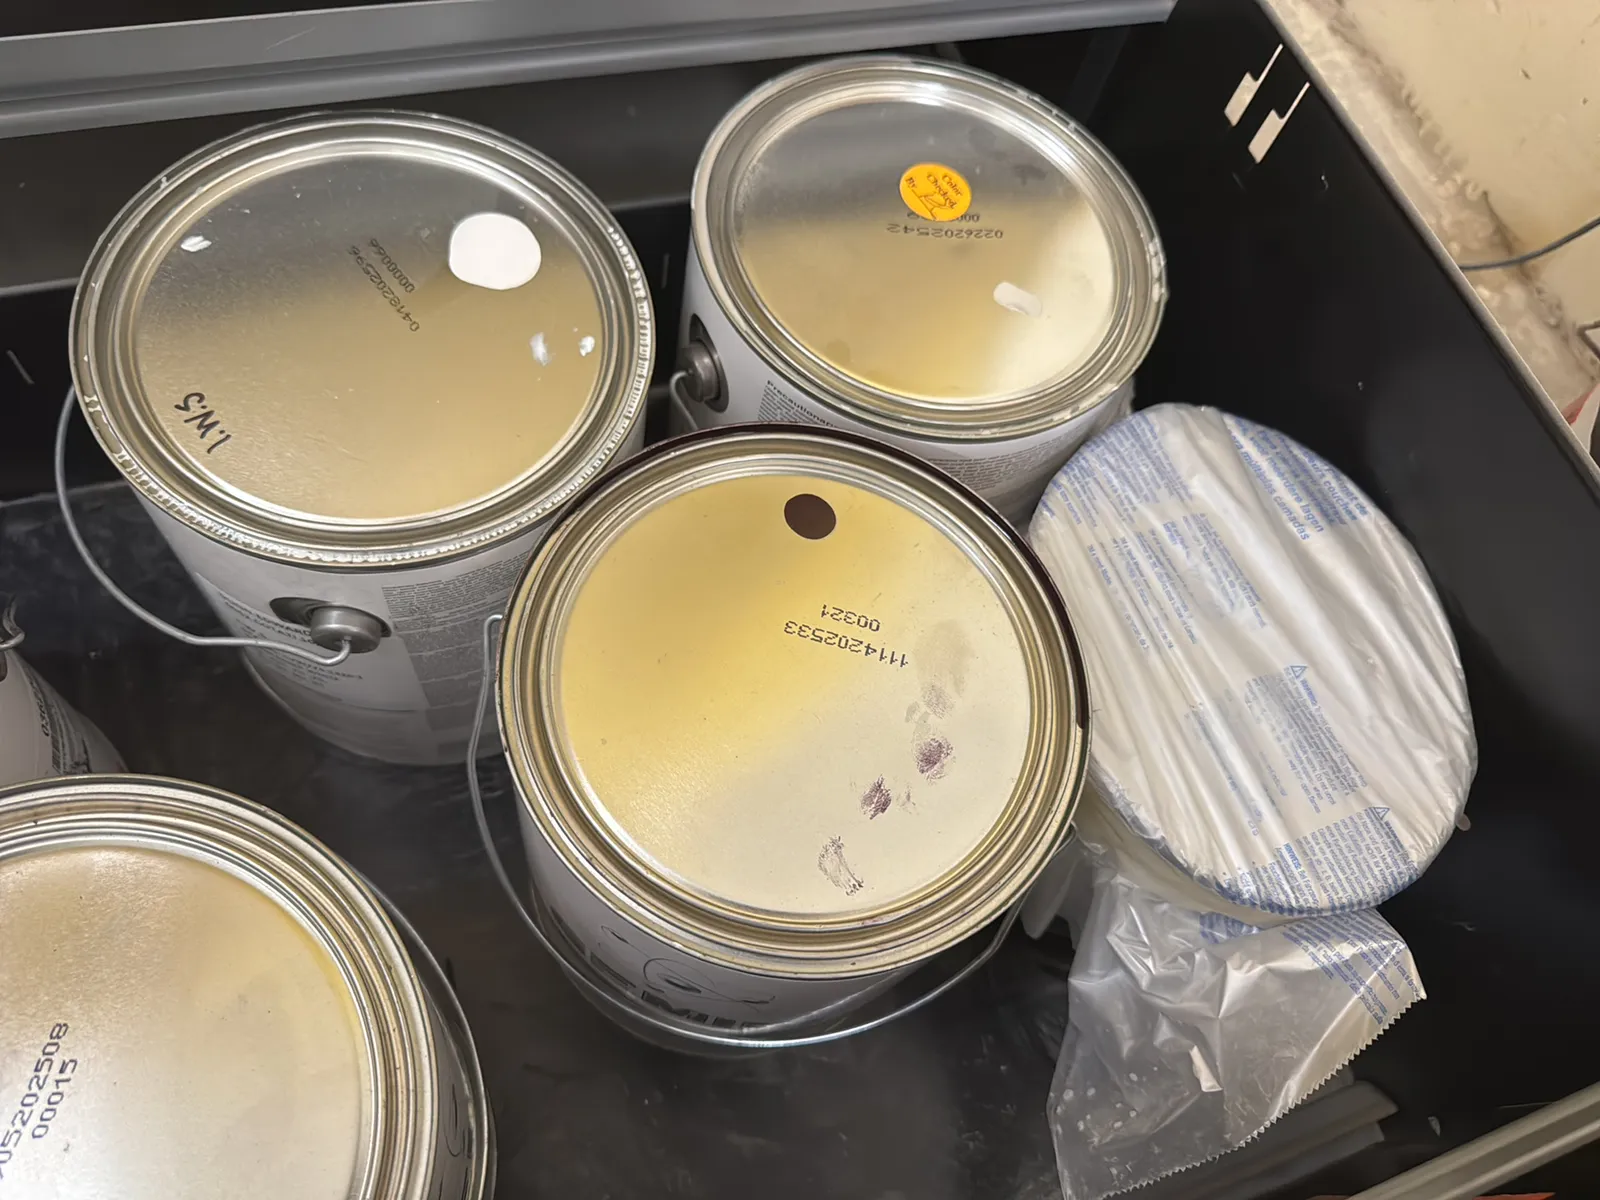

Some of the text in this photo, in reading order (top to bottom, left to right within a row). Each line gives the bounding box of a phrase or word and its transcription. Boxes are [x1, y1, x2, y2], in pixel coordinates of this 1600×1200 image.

[885, 223, 1004, 238] 0226202542
[765, 380, 839, 427] Precautionar
[821, 603, 881, 631] 00321
[784, 621, 908, 667] 1114202533
[31, 1058, 78, 1140] 00015
